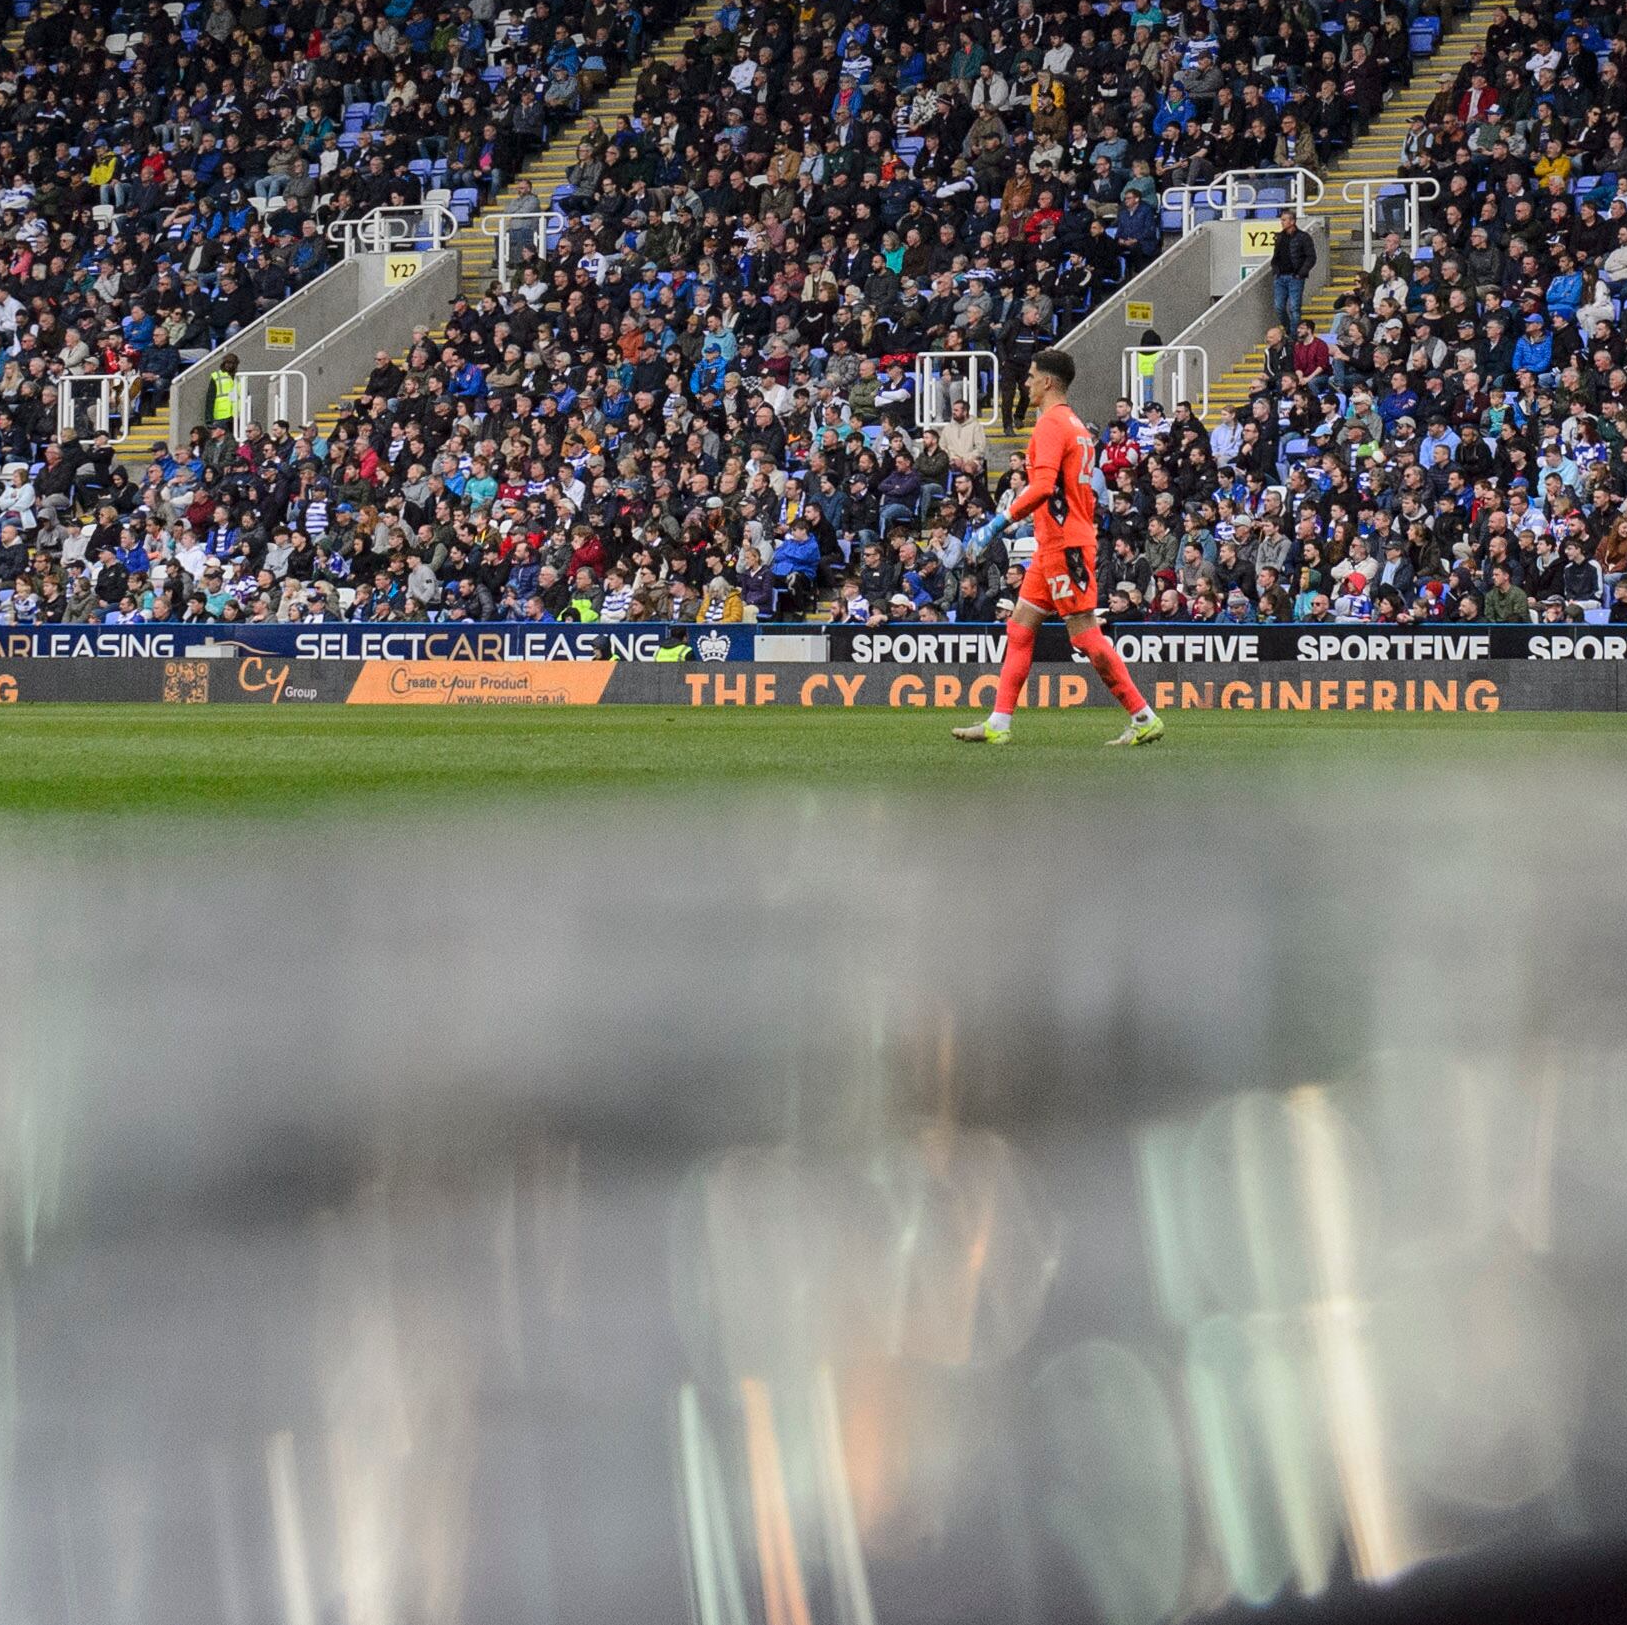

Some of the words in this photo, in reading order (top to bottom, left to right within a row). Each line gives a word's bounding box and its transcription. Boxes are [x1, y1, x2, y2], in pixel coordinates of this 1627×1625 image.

[1247, 231, 1278, 247] Y23
[295, 632, 661, 662] SELECTCARLEASNG
[851, 634, 1010, 664] SPORTFIV
[1071, 634, 1260, 663] ORTFIVE
[1297, 634, 1491, 662] SPORTFIVE
[284, 685, 318, 700] Group
[391, 667, 438, 694] Create
[480, 676, 529, 689] Product
[685, 673, 777, 706] THE
[800, 674, 866, 708] CY
[1154, 678, 1501, 714] ENGINEERING
